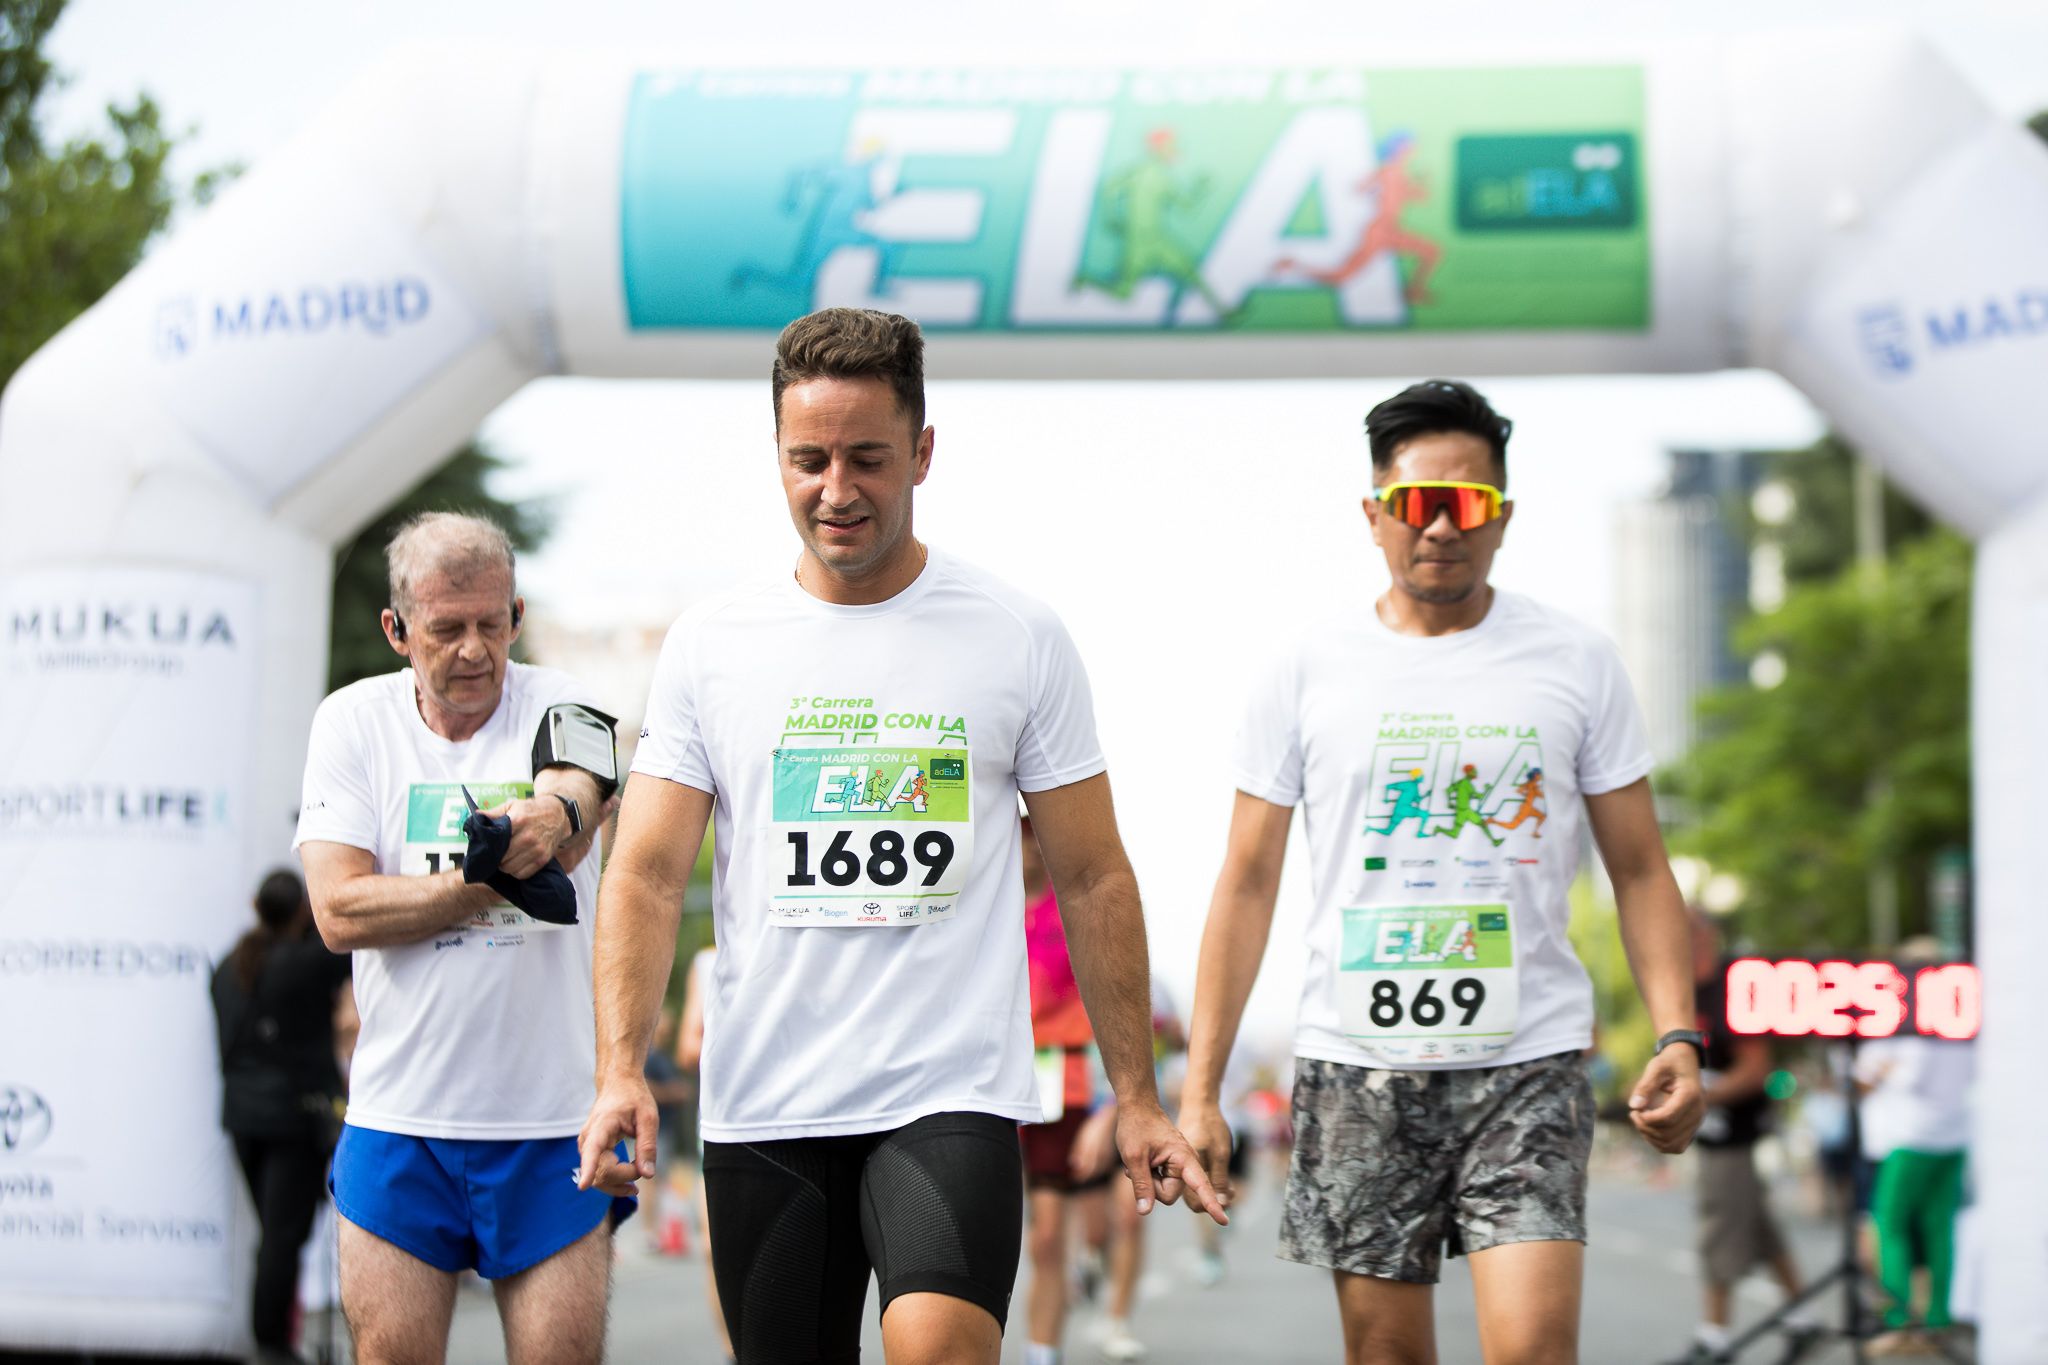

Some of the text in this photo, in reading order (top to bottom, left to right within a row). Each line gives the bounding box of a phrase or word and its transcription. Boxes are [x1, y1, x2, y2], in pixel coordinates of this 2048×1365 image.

[812, 107, 1408, 328] ELA
[211, 273, 430, 338] MADRID
[9, 605, 236, 648] MUKUA
[785, 713, 966, 733] MADRID CON LA
[811, 696, 874, 708] Carrera
[1400, 713, 1454, 722] Carrera
[1377, 726, 1538, 740] MADRID CON LA
[821, 755, 870, 763] MADRID
[873, 754, 900, 763] CON
[903, 754, 918, 763] LA
[811, 765, 928, 813] ELA
[787, 830, 955, 886] 1689
[824, 909, 848, 918] Biogen
[1373, 920, 1477, 963] ELA
[1370, 978, 1486, 1027] 869
